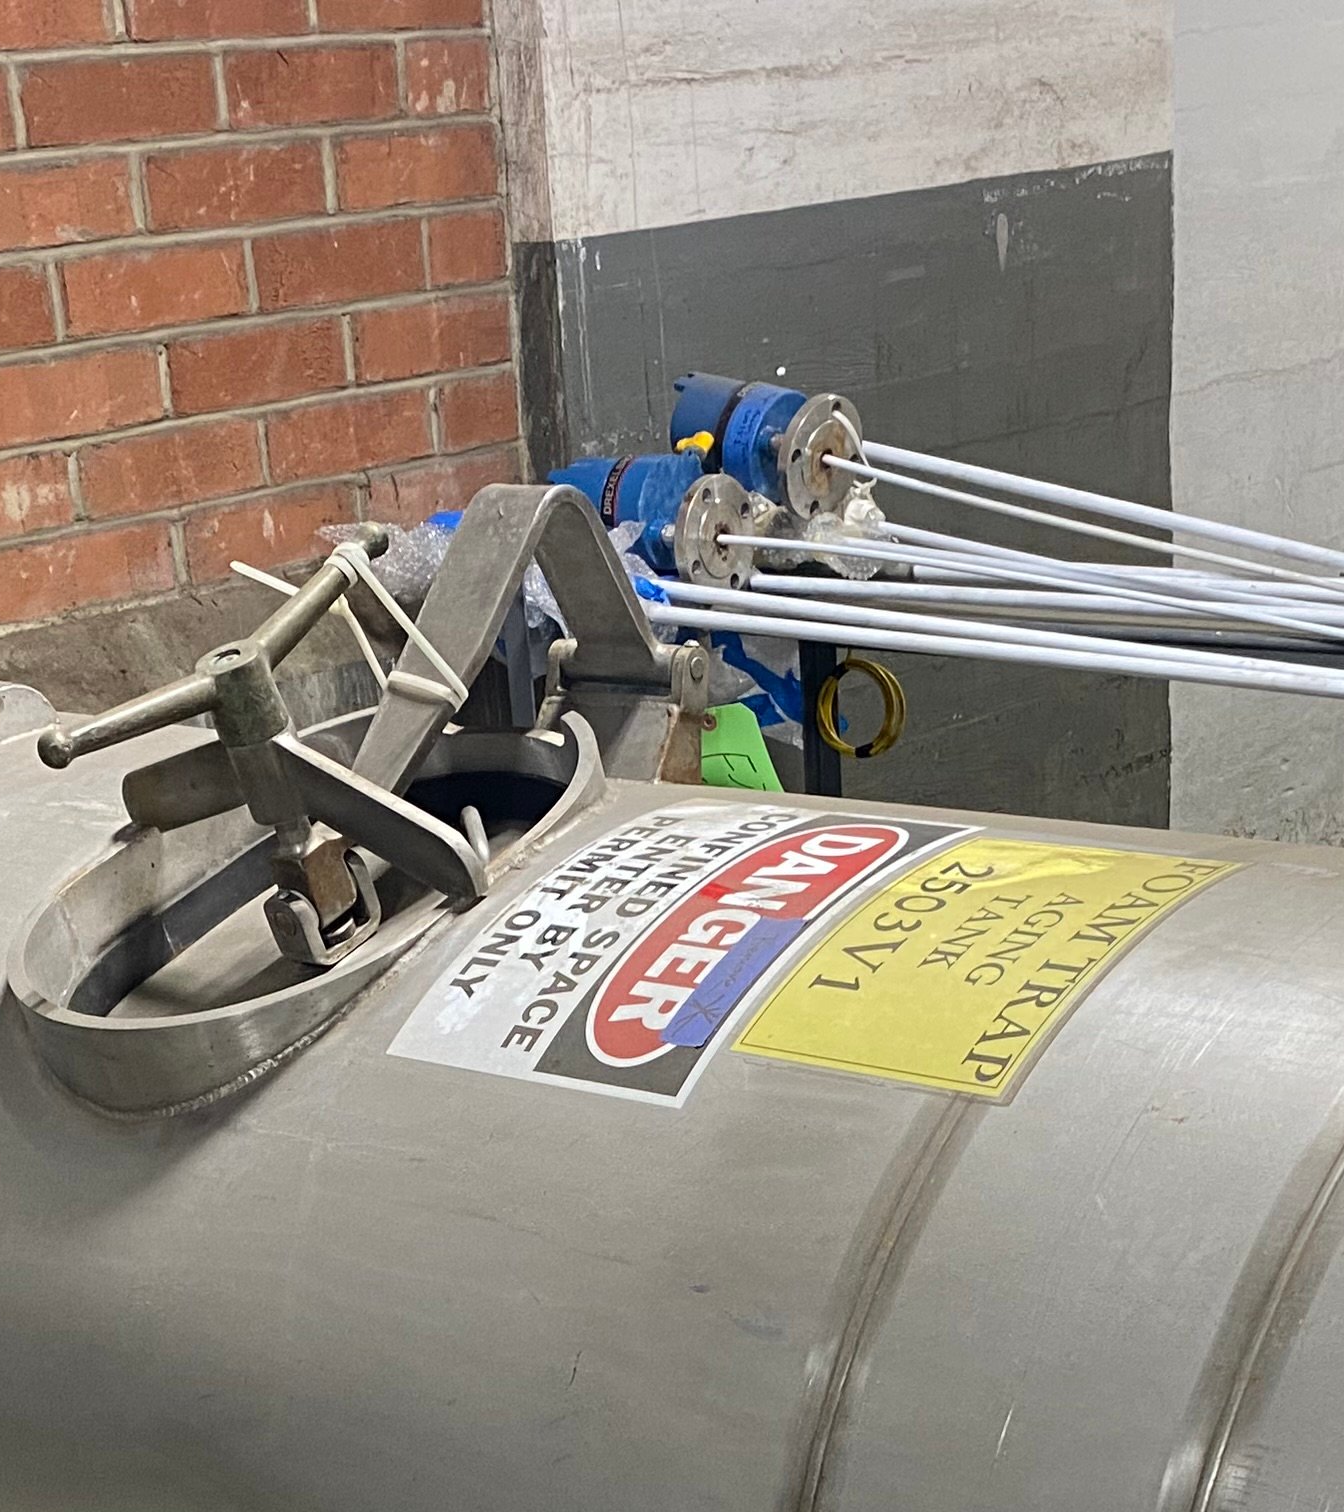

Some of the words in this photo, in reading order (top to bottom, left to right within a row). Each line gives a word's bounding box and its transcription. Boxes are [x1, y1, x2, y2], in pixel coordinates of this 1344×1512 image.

[541, 816, 684, 901] PERMIT
[568, 834, 698, 914] ENTER
[616, 813, 798, 918] CONFINED
[1067, 861, 1227, 947] FOAM
[449, 909, 542, 999] ONLY
[519, 923, 579, 972] BY
[608, 833, 886, 1031] DANGER
[807, 860, 995, 992] 2503V1
[916, 894, 1034, 970] TANK
[964, 892, 1085, 986] AGING
[501, 927, 620, 1053] SPACE
[960, 956, 1098, 1083] TRAP
